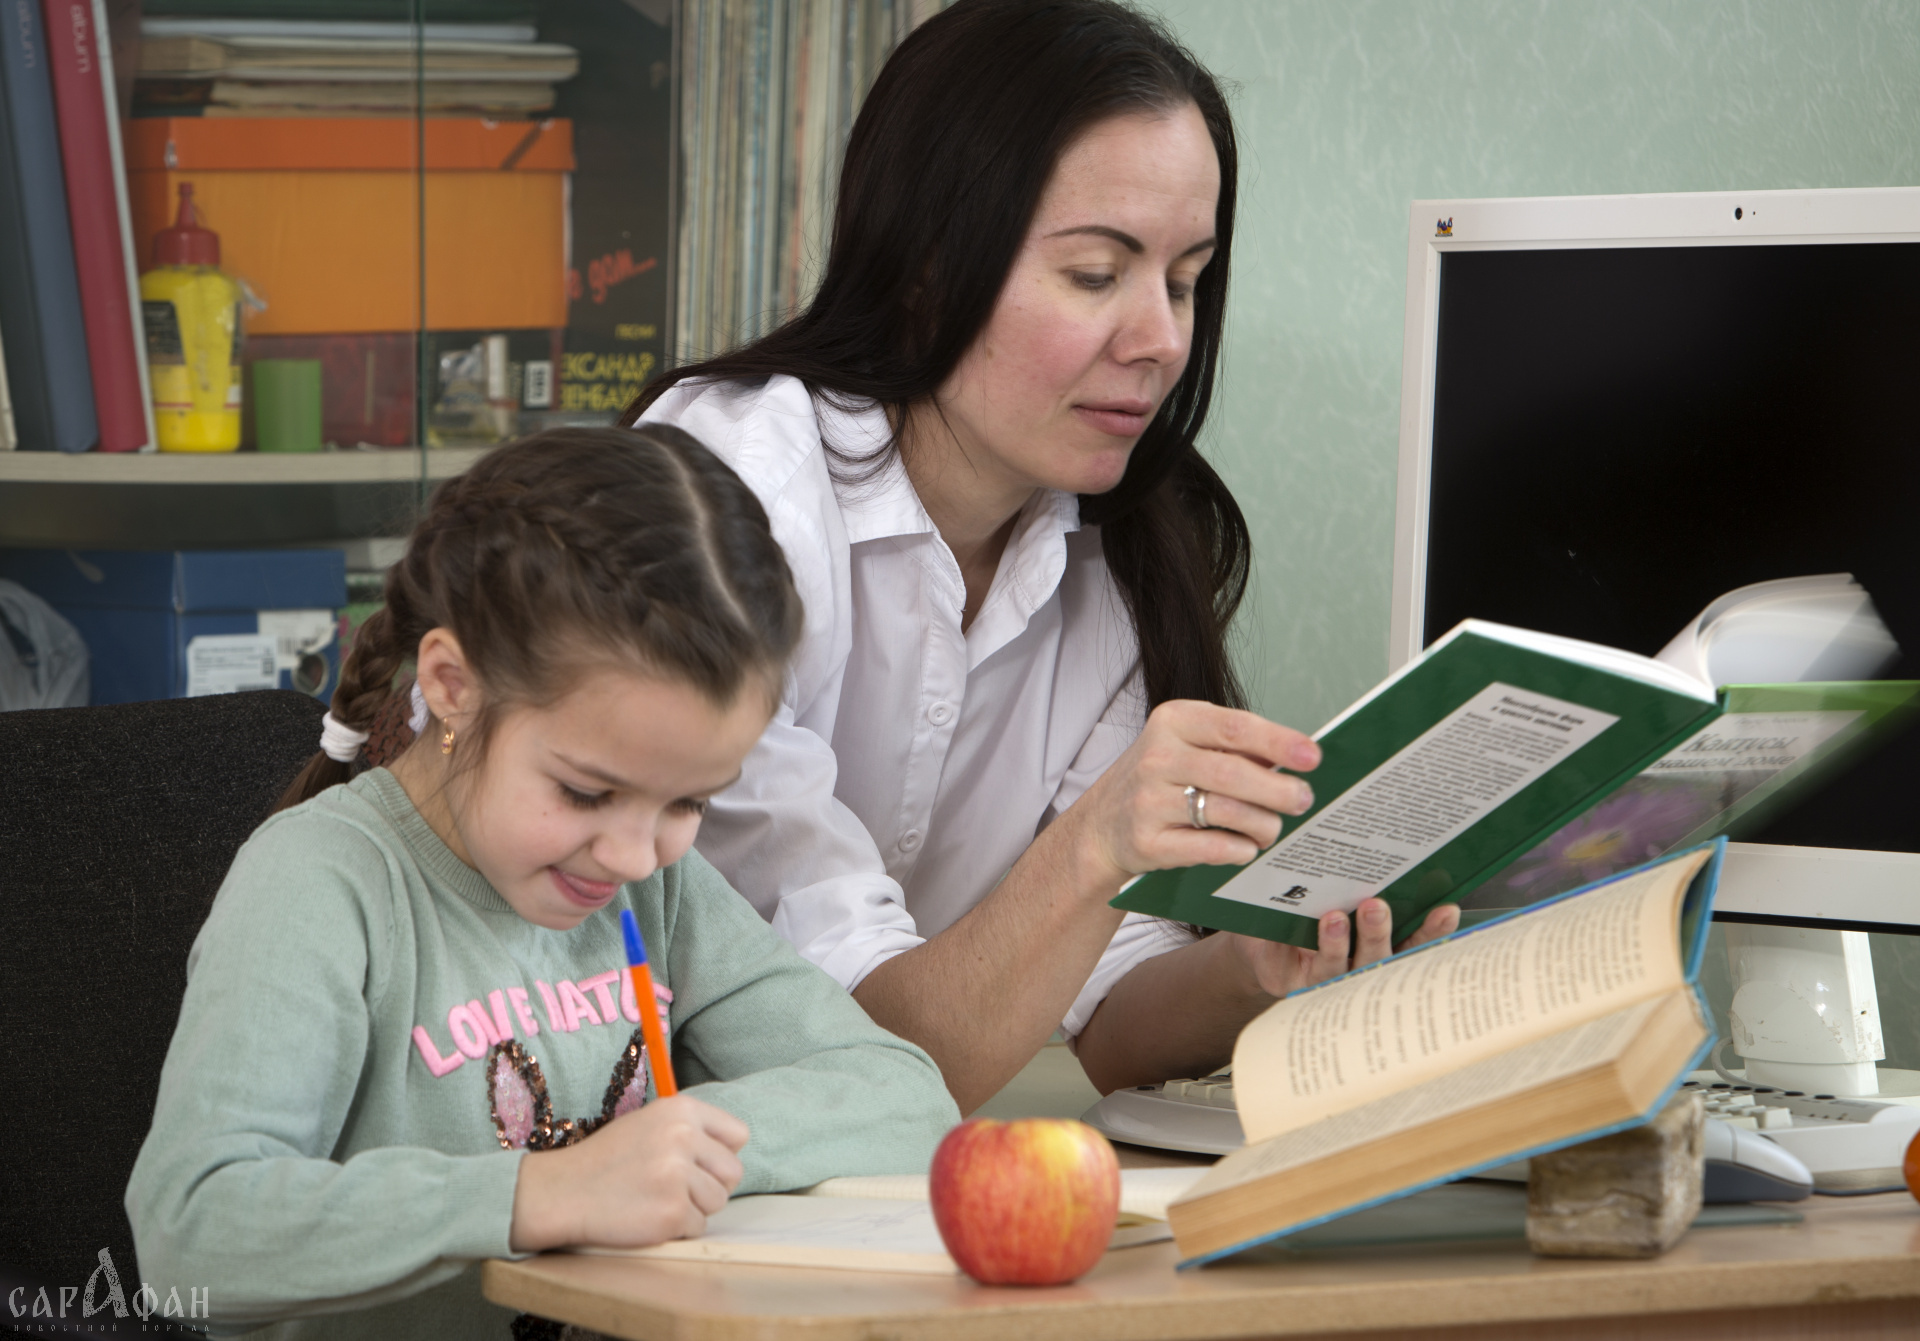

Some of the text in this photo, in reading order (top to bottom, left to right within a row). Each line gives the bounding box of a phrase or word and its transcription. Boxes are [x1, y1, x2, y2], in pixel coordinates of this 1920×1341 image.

[17, 0, 36, 68] album
[70, 4, 91, 73] album
[562, 352, 655, 382] ЕКСАНДР
[412, 985, 539, 1078] LOVE
